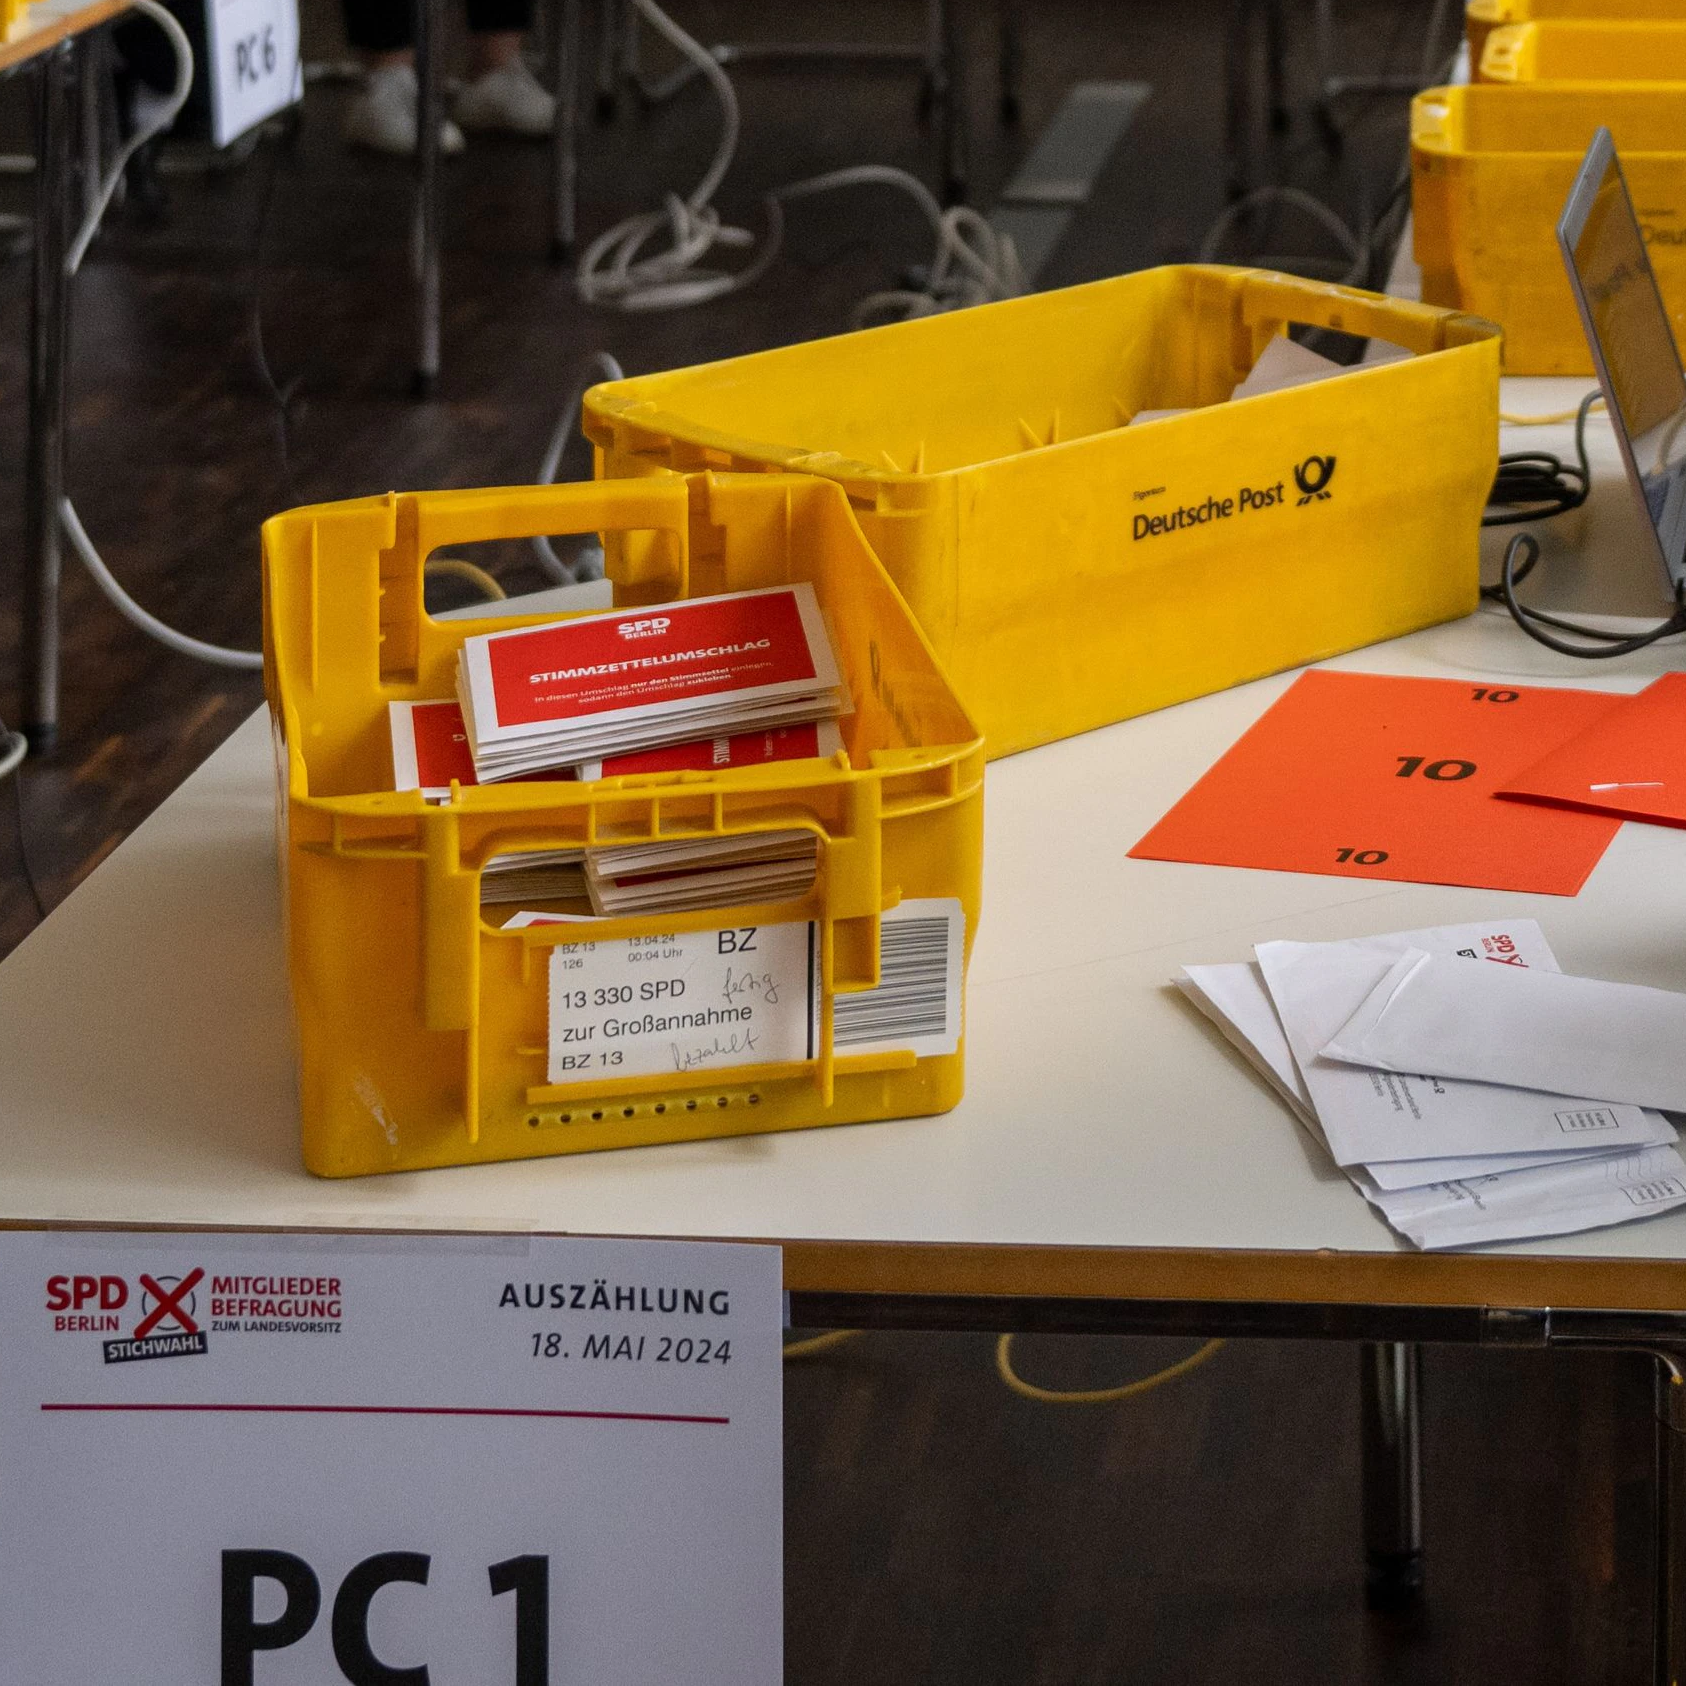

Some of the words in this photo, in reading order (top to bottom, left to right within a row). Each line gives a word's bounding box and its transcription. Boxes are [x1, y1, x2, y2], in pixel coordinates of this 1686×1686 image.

[236, 33, 259, 91] PC
[263, 23, 276, 75] 6
[1133, 495, 1234, 541] Deutsche
[1239, 481, 1284, 513] Post
[618, 617, 671, 634] SPD
[625, 628, 667, 640] BERLIN
[530, 638, 771, 684] STIMMZETTELUMSCHLAG
[546, 692, 578, 702] diesen
[580, 684, 629, 696] Umschlag
[630, 681, 647, 689] nur
[649, 676, 668, 685] den
[669, 667, 729, 683] Stimmzettel
[578, 694, 614, 704] sodann
[616, 689, 635, 697] den
[636, 680, 685, 694] Umschlag
[1470, 687, 1520, 703] 10
[1394, 755, 1477, 782] 10
[1335, 847, 1389, 865] 10
[562, 943, 579, 955] BZ
[582, 941, 596, 953] 13
[627, 933, 675, 947] 13.04.24
[718, 926, 757, 954] BZ
[1491, 934, 1516, 953] SPD
[562, 958, 584, 970] 126
[627, 950, 659, 963] 00:04
[663, 947, 683, 959] Uhr
[562, 990, 587, 1009] 13
[594, 985, 633, 1006] 330
[639, 979, 686, 1001] SPD
[562, 1025, 596, 1043] zur
[603, 1005, 753, 1038] Großannahme
[561, 1053, 591, 1071] BZ
[599, 1050, 624, 1067] 13
[45, 1275, 129, 1311] SPD
[211, 1275, 342, 1297] MITGLIEDER
[499, 1278, 730, 1316] AUSZÄHLUNG
[211, 1297, 342, 1318] BEFRAGUNG
[54, 1315, 120, 1332] BERLIN
[211, 1320, 241, 1332] ZUM
[244, 1320, 342, 1334] LANDESVORSITZ
[108, 1336, 203, 1360] STICHWAHL
[531, 1332, 569, 1359] 18.
[582, 1333, 646, 1361] MAI
[656, 1336, 732, 1365] 2024
[221, 1548, 432, 1686] PC
[487, 1554, 549, 1686] 1
